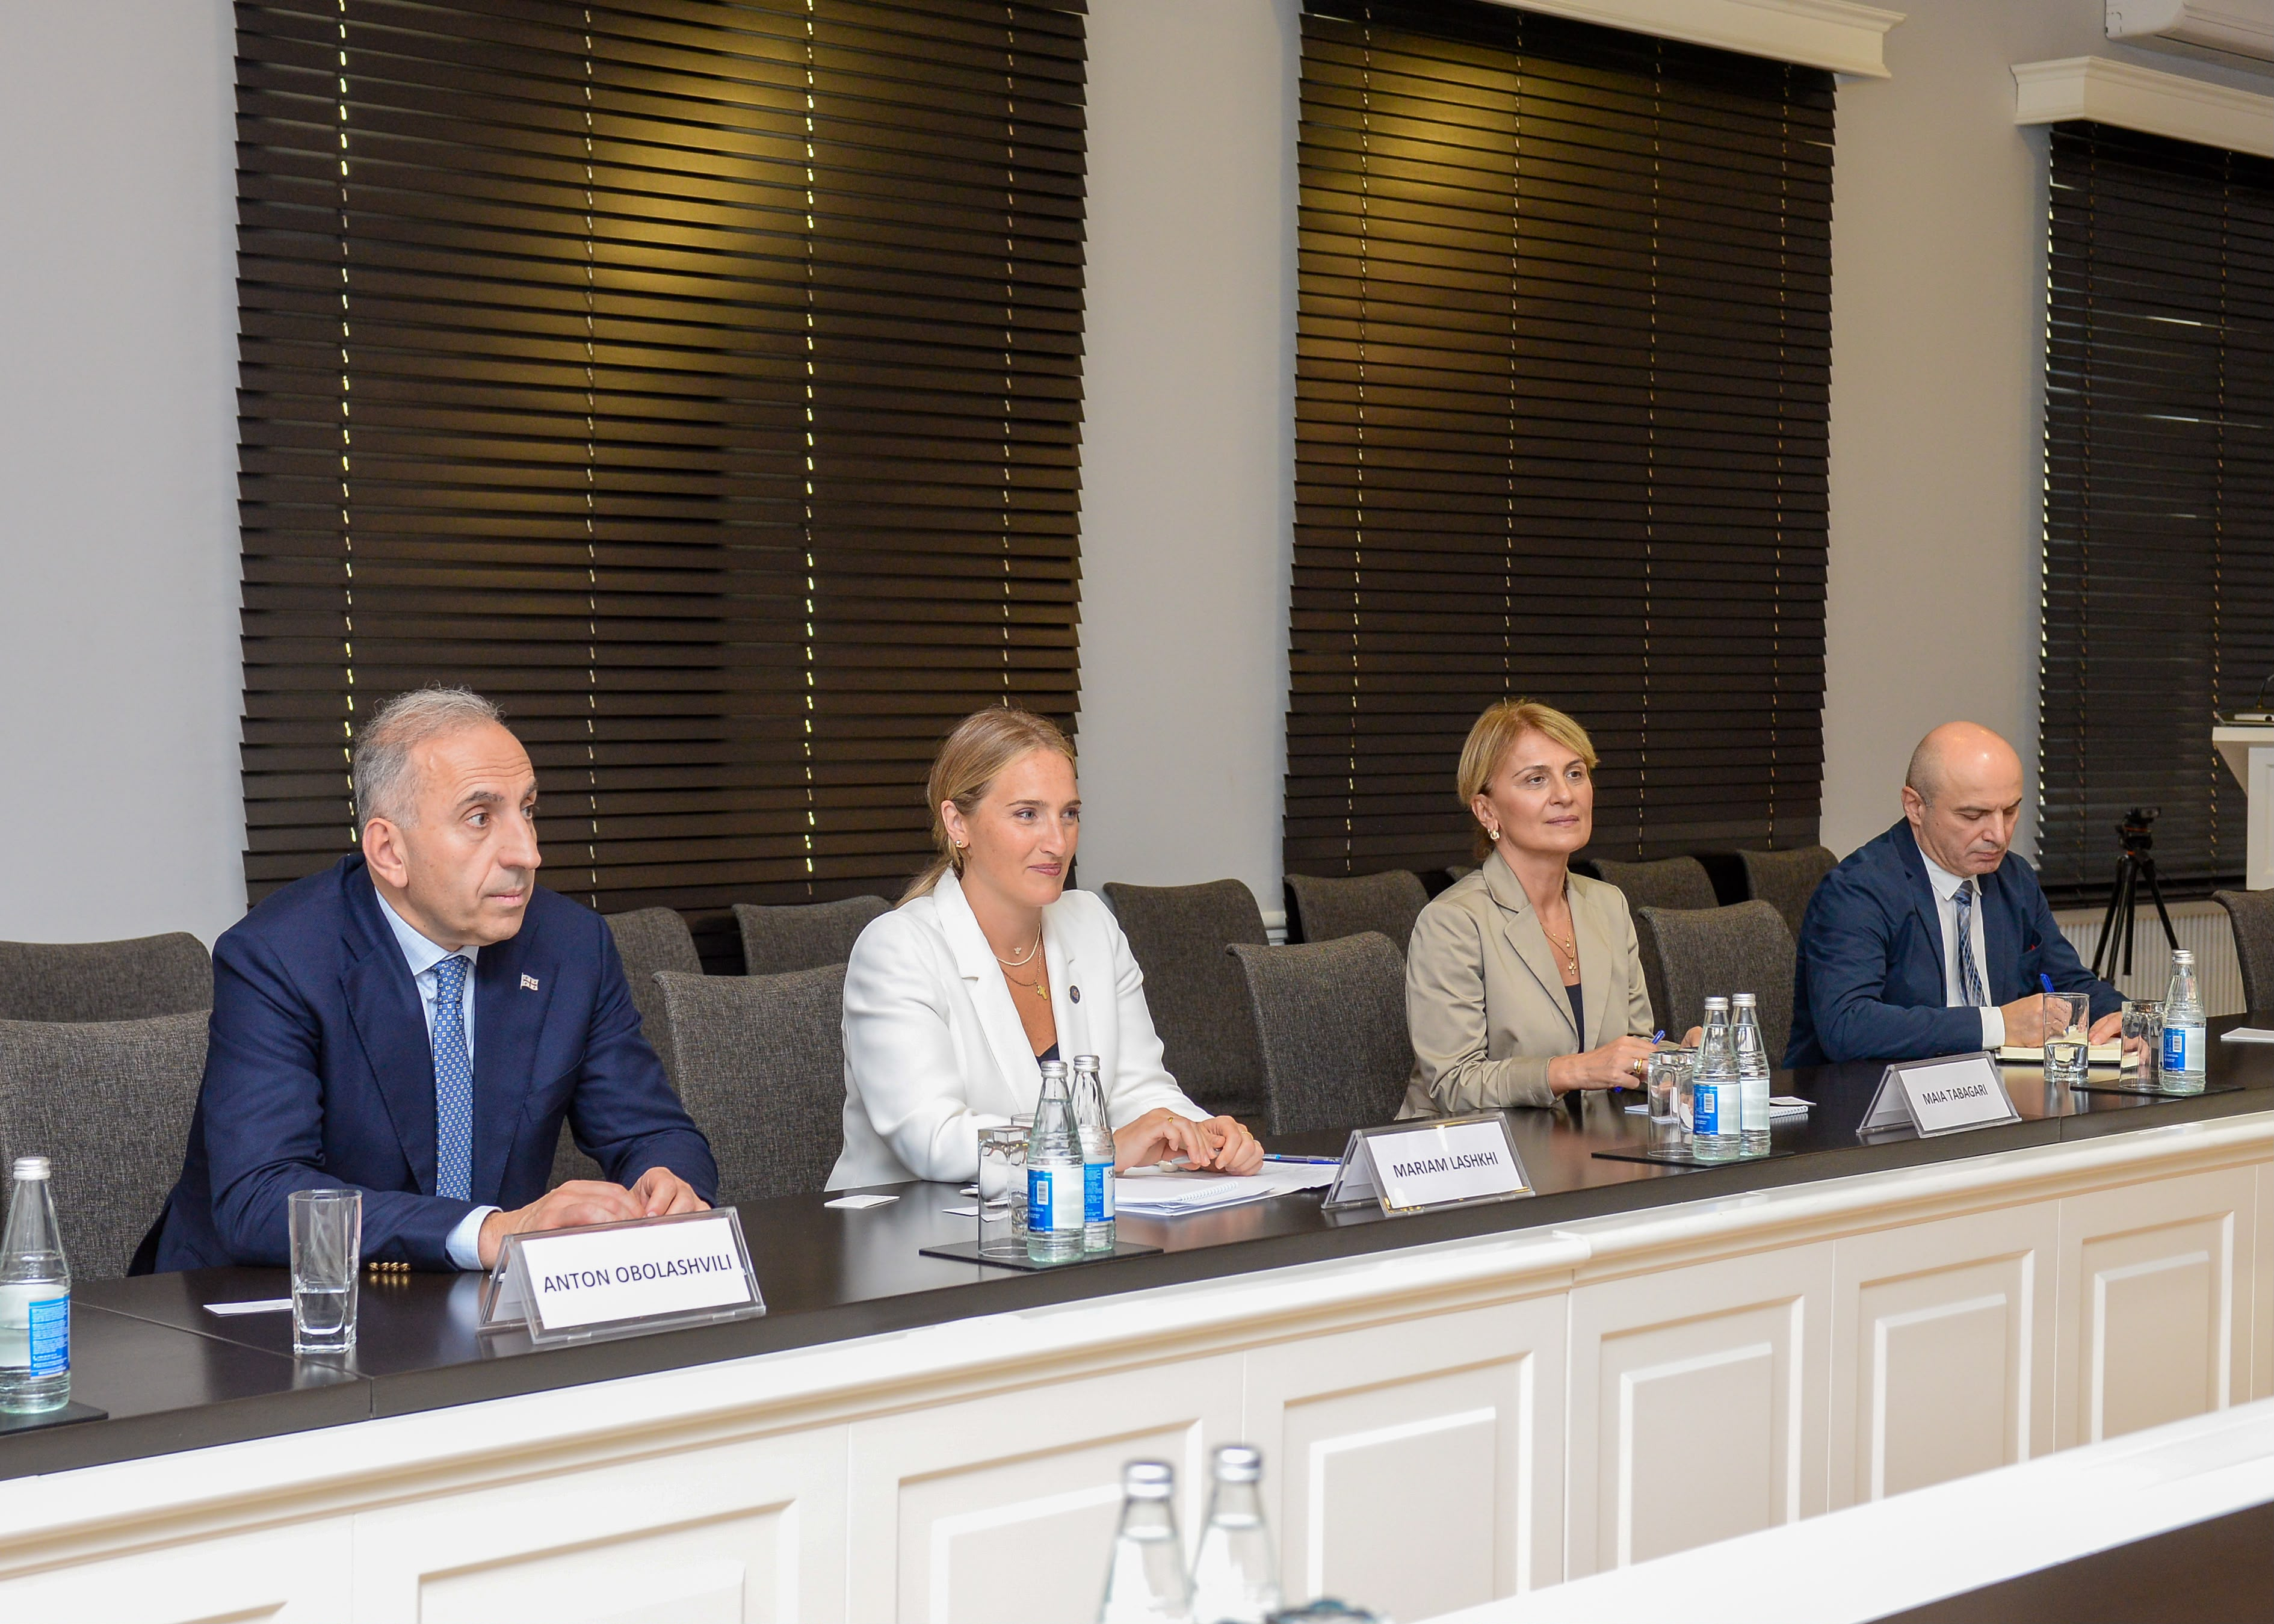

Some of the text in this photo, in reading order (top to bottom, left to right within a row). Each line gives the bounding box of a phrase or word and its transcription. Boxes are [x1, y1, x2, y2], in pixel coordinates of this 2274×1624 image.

[1922, 1084, 1988, 1105] MAIA TABAGARI
[1392, 1152, 1498, 1178] MARIAM LASHKHI
[545, 1254, 732, 1293] ANTON OBOLASHVILI
